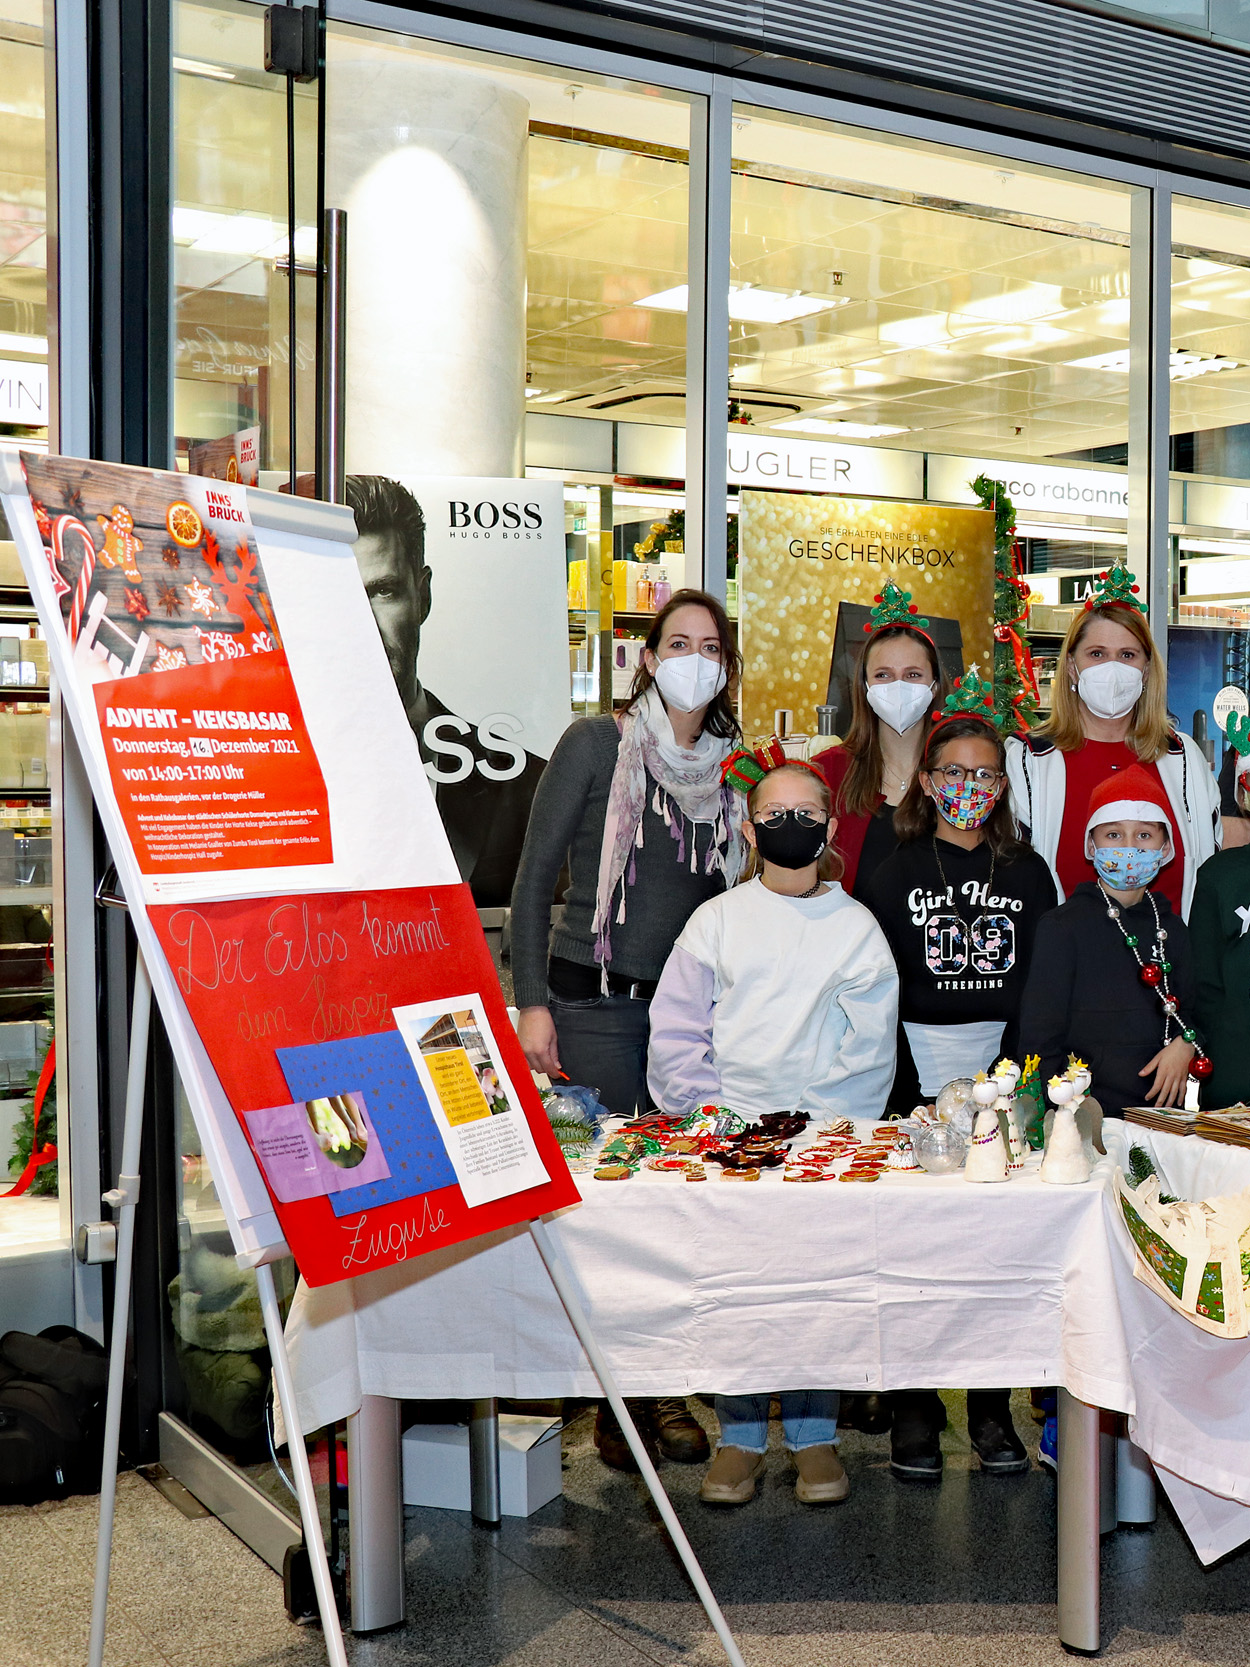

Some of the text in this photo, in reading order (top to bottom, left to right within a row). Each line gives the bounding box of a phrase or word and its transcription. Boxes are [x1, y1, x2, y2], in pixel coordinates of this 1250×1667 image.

[728, 448, 851, 482] UGLER
[208, 504, 246, 523] BRUCK
[448, 501, 543, 529] BOSS
[502, 532, 543, 540] BOSS
[820, 526, 929, 543] SIE ERHALTEN EINE EDLE
[788, 539, 956, 568] GESCHENKBOX
[105, 707, 178, 728] ADVENT
[192, 709, 293, 731] KEKSBASAR
[112, 737, 191, 758] Donnerstag,
[210, 737, 270, 753] Dezember
[270, 739, 300, 754] 2021
[422, 712, 528, 784] SS
[122, 768, 149, 781] von
[221, 763, 245, 780] Uhr
[130, 790, 266, 804] in den Rathausgalerien, vor der Drogerie Müller
[908, 880, 1023, 926] Girl Hero
[168, 893, 451, 995] Der Erlös kommt
[925, 914, 1016, 975] 09
[937, 979, 1003, 990] #TRENDING
[237, 974, 392, 1042] dem Hospiz
